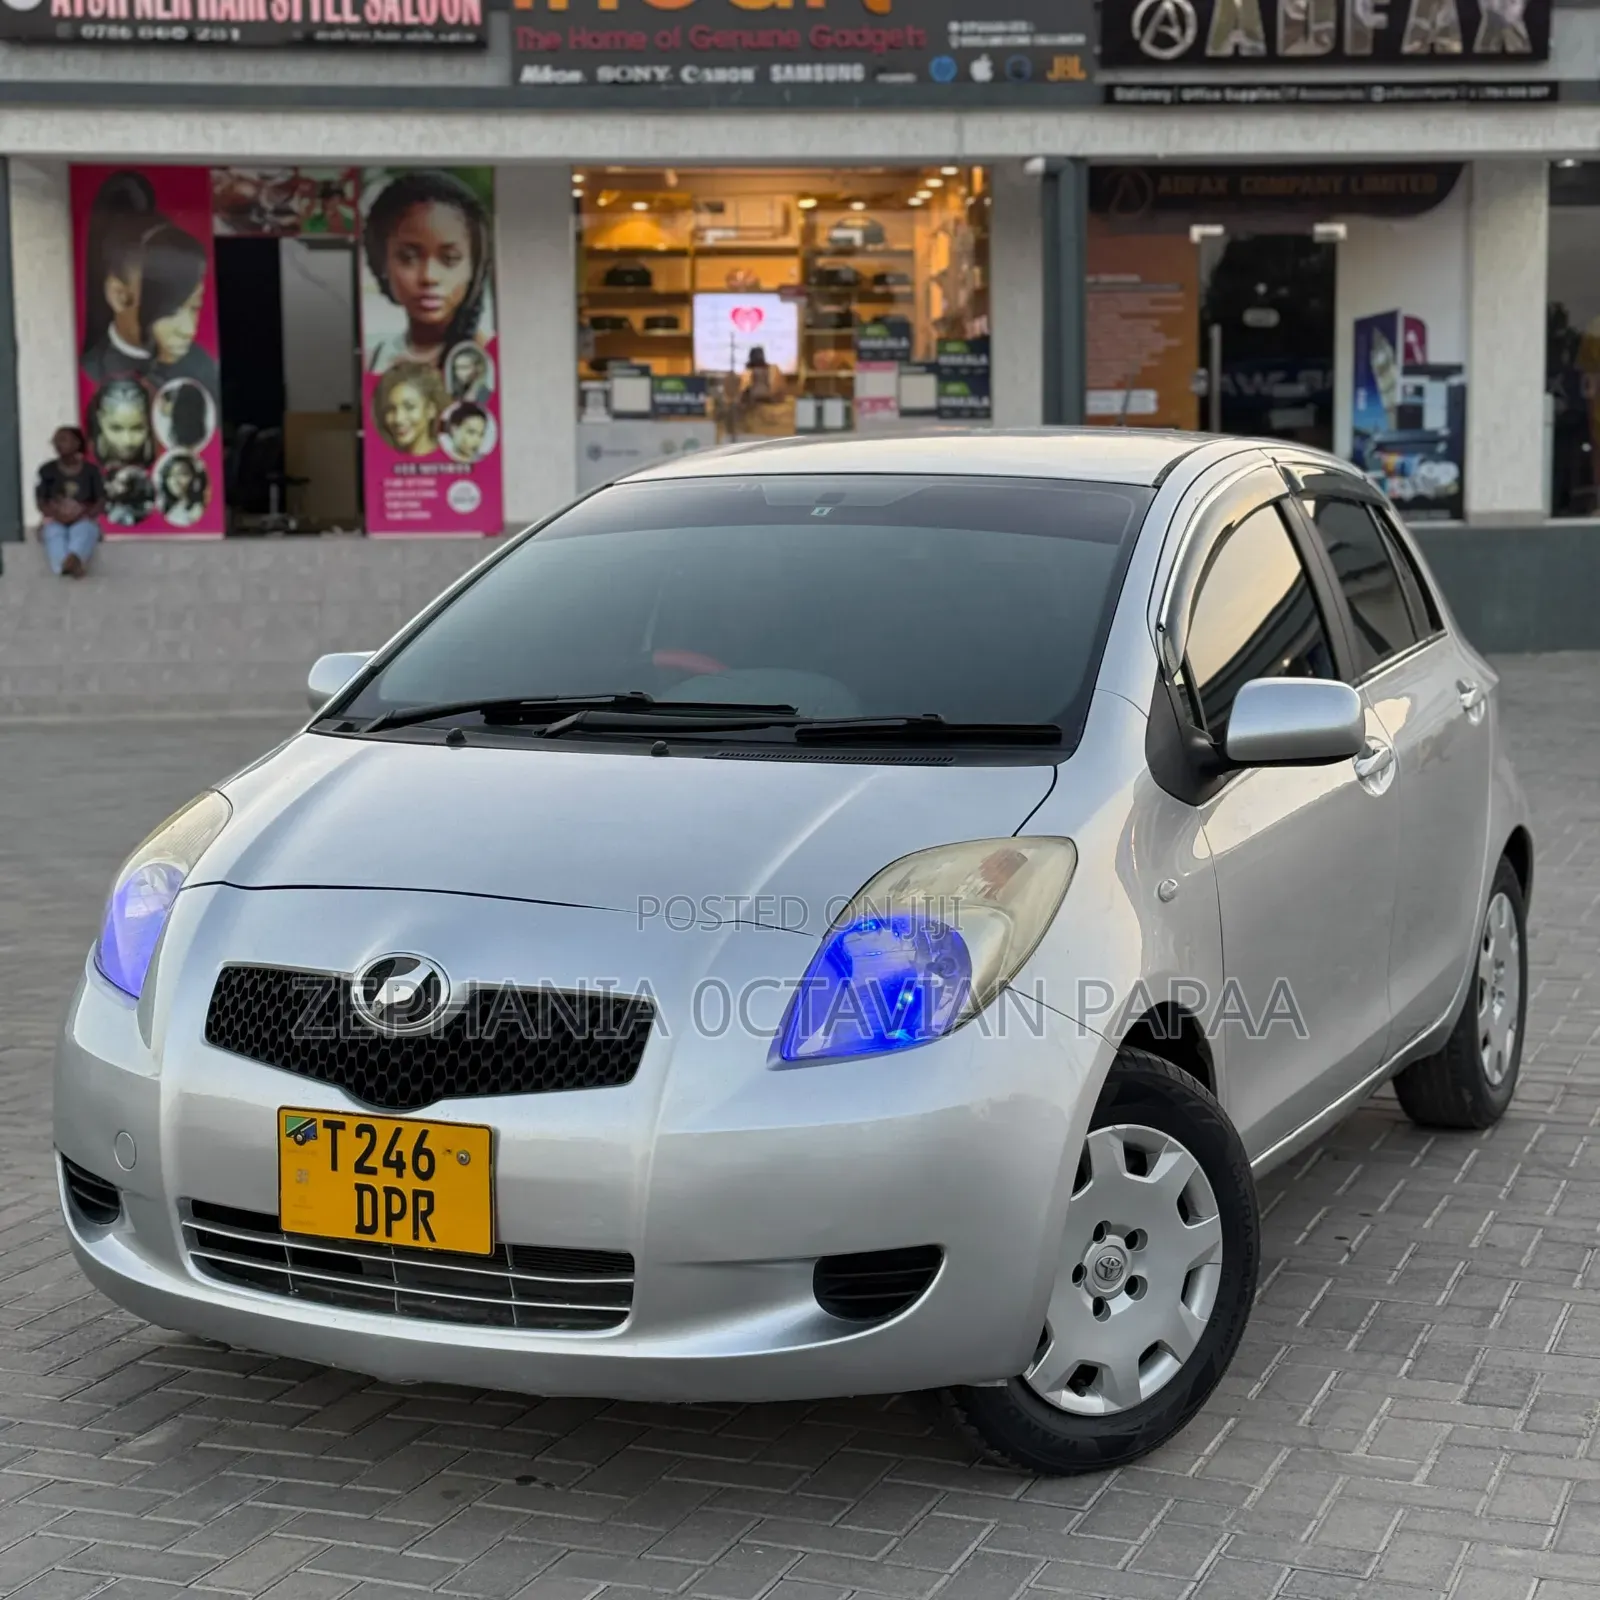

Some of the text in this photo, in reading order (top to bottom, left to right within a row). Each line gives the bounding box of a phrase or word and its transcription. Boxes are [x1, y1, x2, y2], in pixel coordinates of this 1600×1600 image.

[515, 25, 563, 50] The
[568, 25, 648, 50] Home
[655, 24, 682, 50] of
[596, 64, 671, 83] SONY
[769, 63, 866, 83] SAMSUNG
[1241, 175, 1344, 195] COMPANY
[1351, 173, 1438, 194] LIMITED
[322, 1119, 436, 1181] T 246
[354, 1182, 437, 1243] DPR
